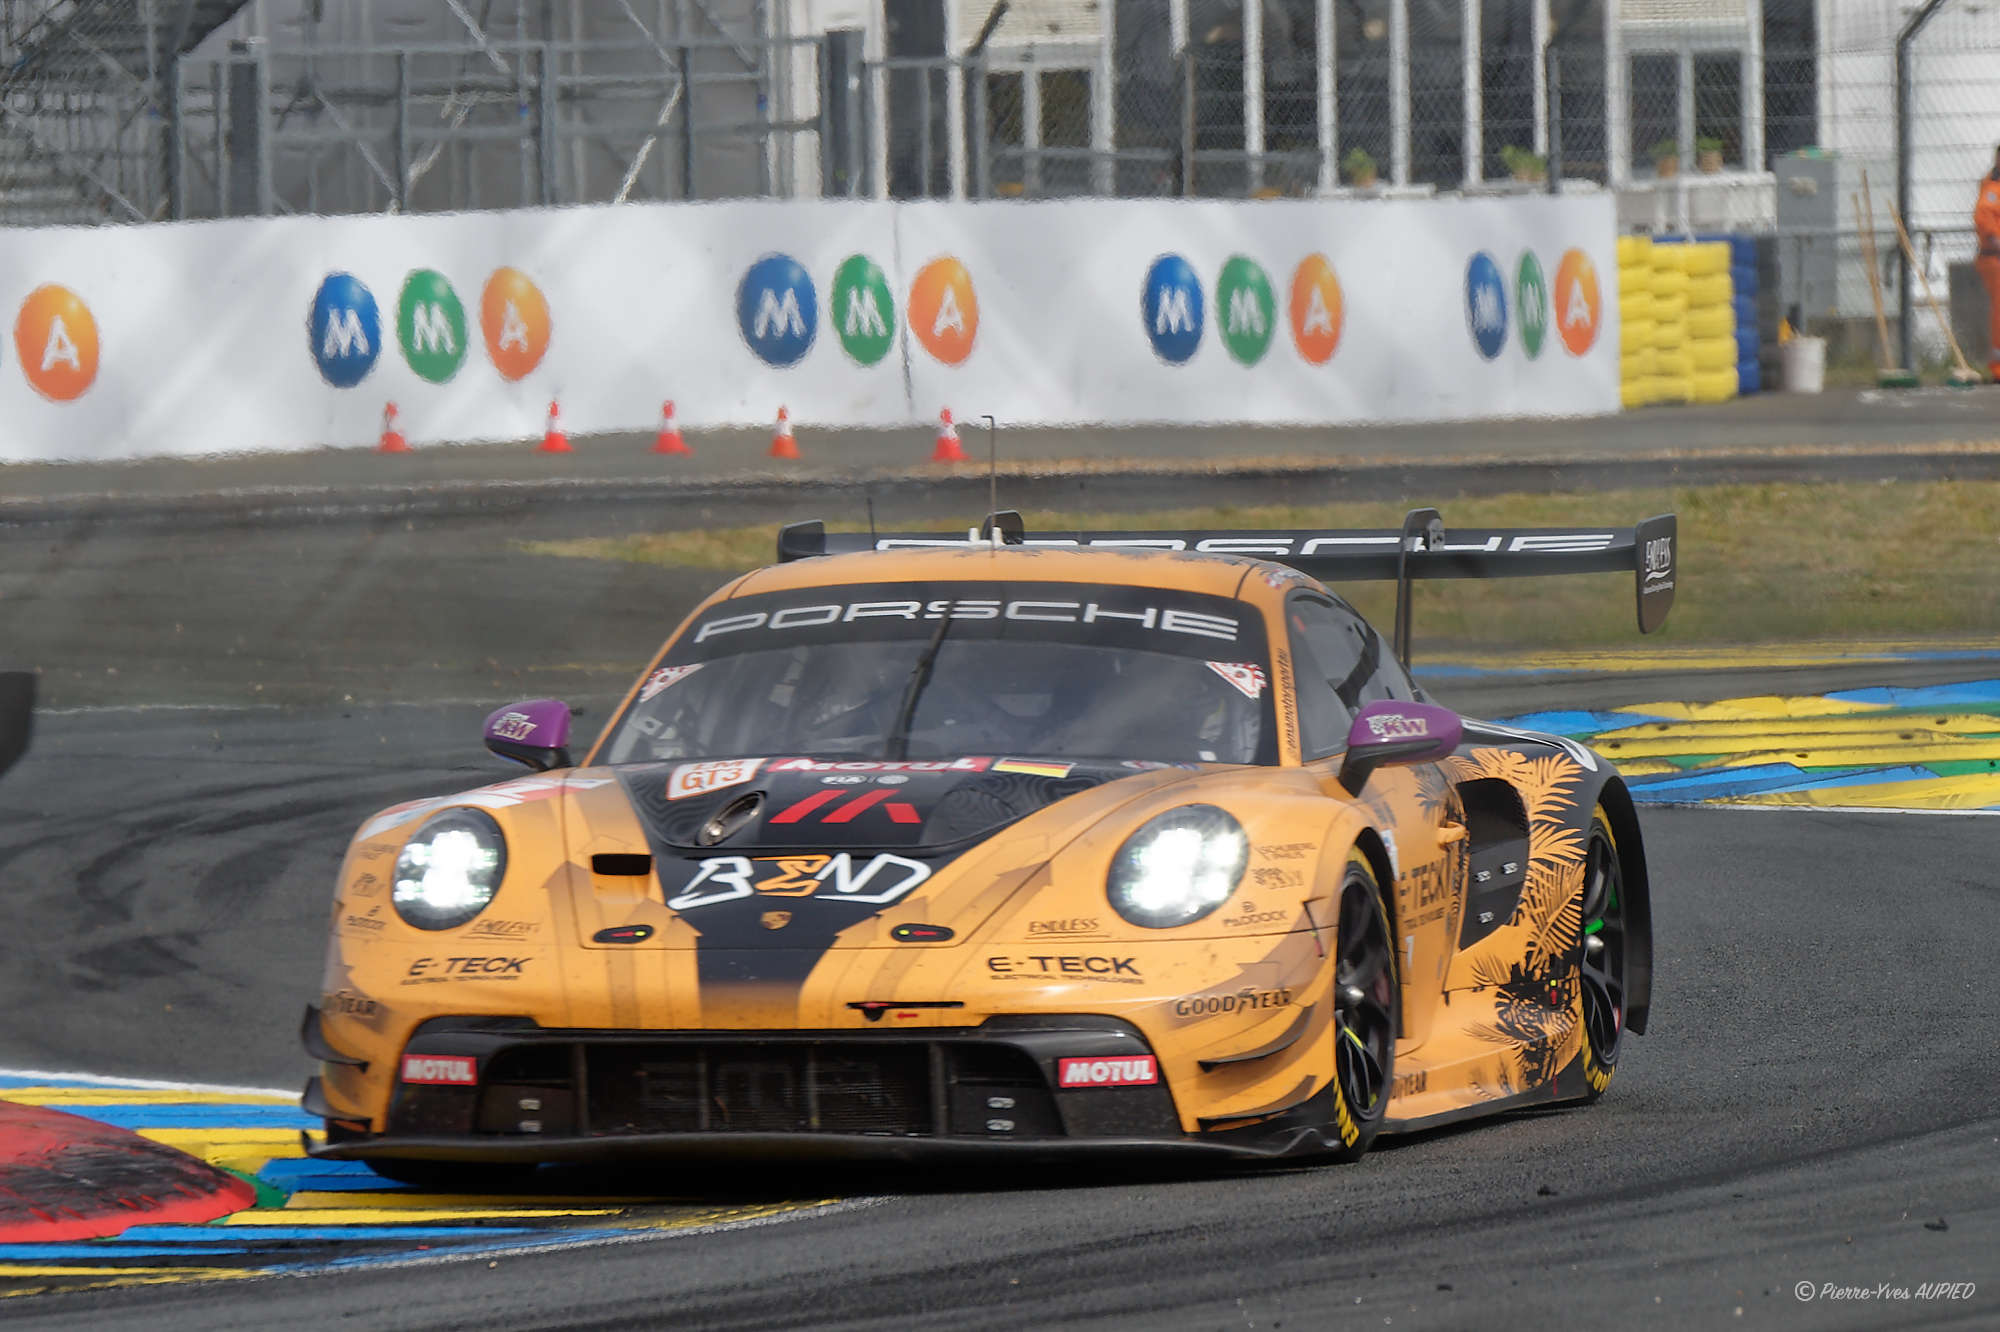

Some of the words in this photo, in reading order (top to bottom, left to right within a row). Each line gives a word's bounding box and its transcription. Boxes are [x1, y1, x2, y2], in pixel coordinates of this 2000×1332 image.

[693, 600, 1239, 643] PORSCHE
[681, 768, 742, 790] GT3
[1029, 917, 1100, 933] ENDLESS
[408, 956, 533, 976] E-TECK
[987, 955, 1142, 975] E-TECK
[1175, 988, 1293, 1016] GOODYEAR
[403, 1059, 473, 1081] MOTUL
[1063, 1060, 1154, 1084] MOTUL
